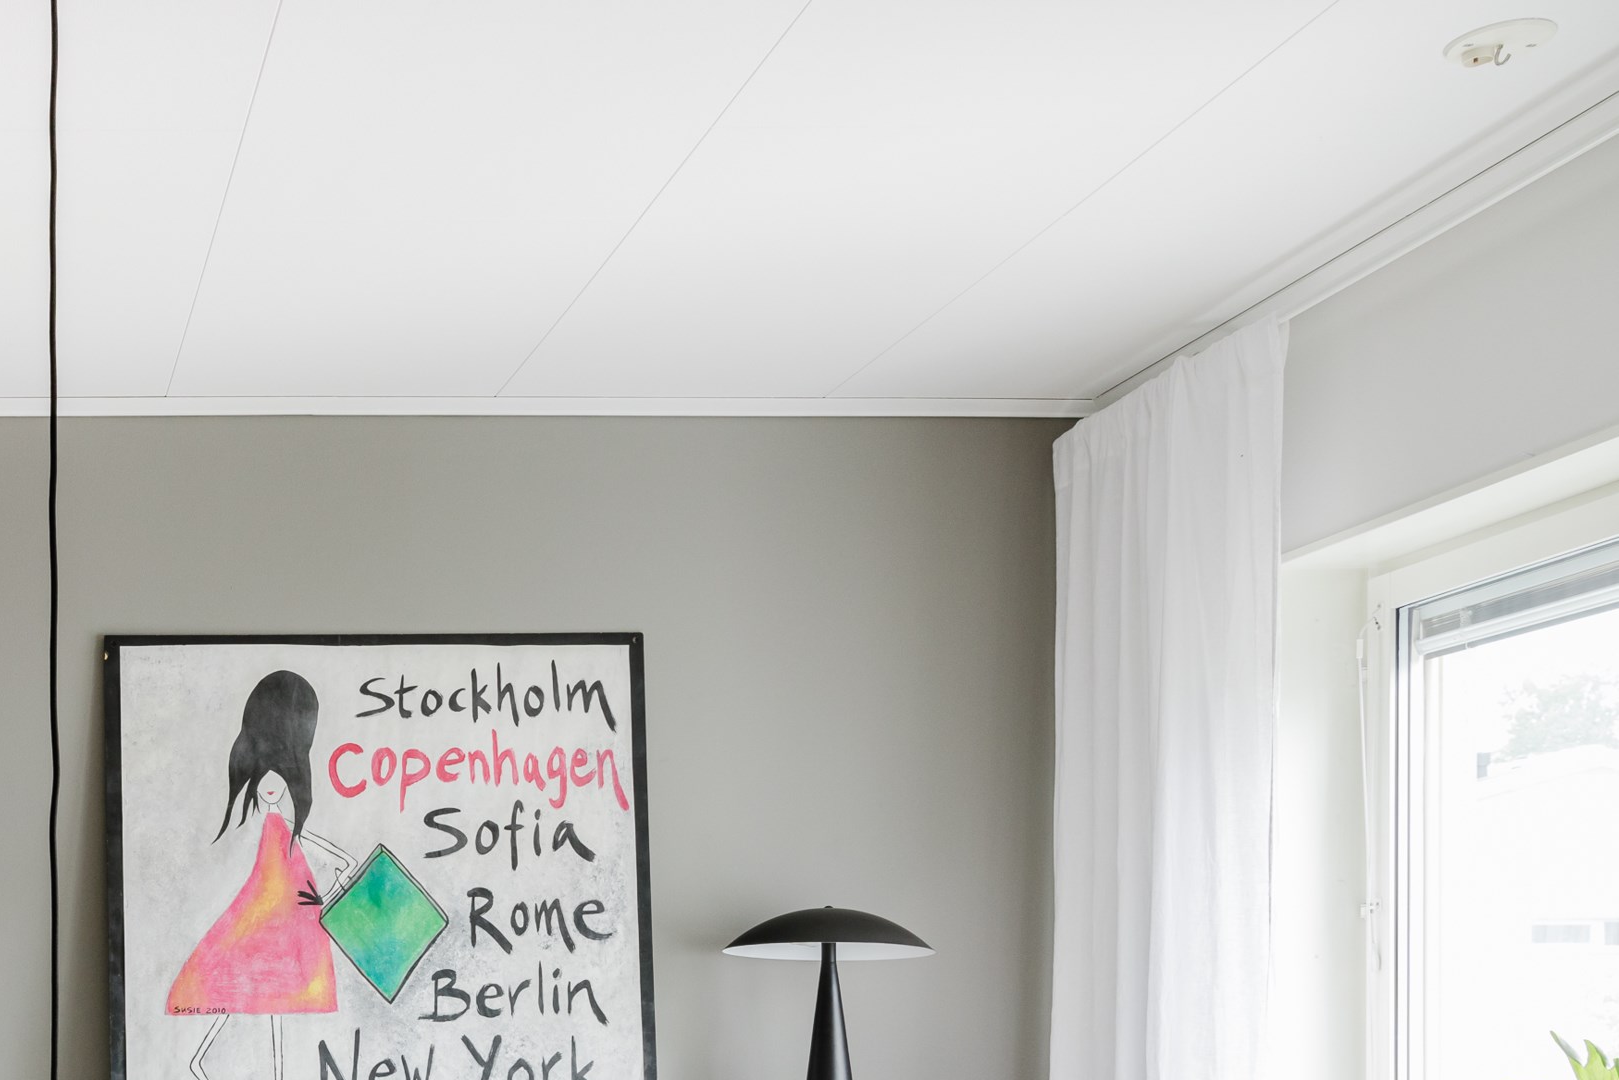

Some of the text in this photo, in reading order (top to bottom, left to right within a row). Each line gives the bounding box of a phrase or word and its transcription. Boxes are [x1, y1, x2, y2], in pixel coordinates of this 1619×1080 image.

[356, 660, 617, 733] Stockholm
[328, 729, 629, 813] Copenhagen
[423, 800, 596, 870] Sofia
[466, 887, 616, 954] Rome
[418, 961, 609, 1025] Berlin
